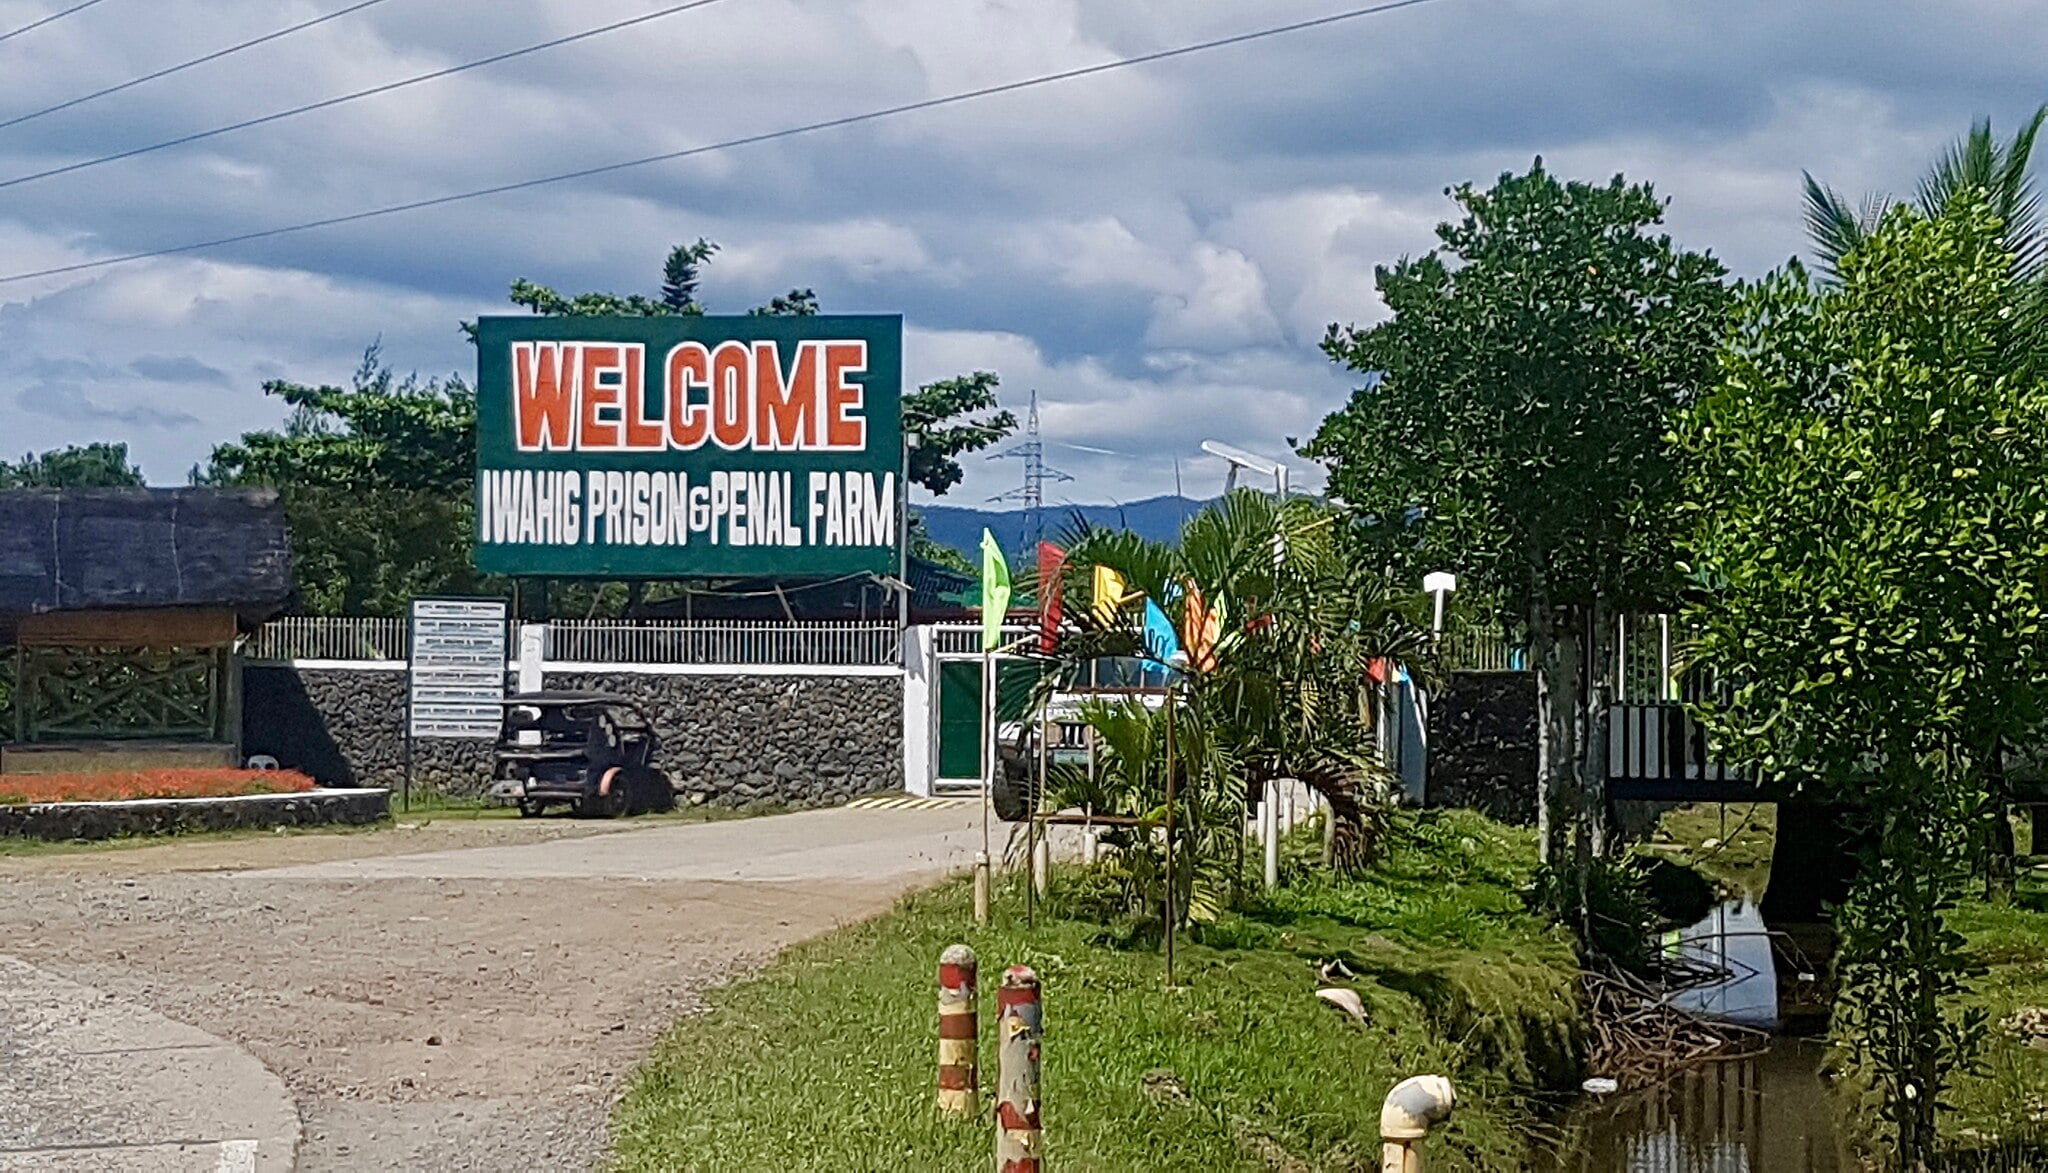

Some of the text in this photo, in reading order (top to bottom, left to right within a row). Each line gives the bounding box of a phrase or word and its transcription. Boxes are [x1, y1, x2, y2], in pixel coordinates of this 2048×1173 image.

[511, 340, 868, 451] WELCOME
[482, 469, 580, 545] IWAHIG
[587, 470, 688, 546] PRISON
[711, 471, 801, 546] PENAL
[809, 471, 895, 547] FARM
